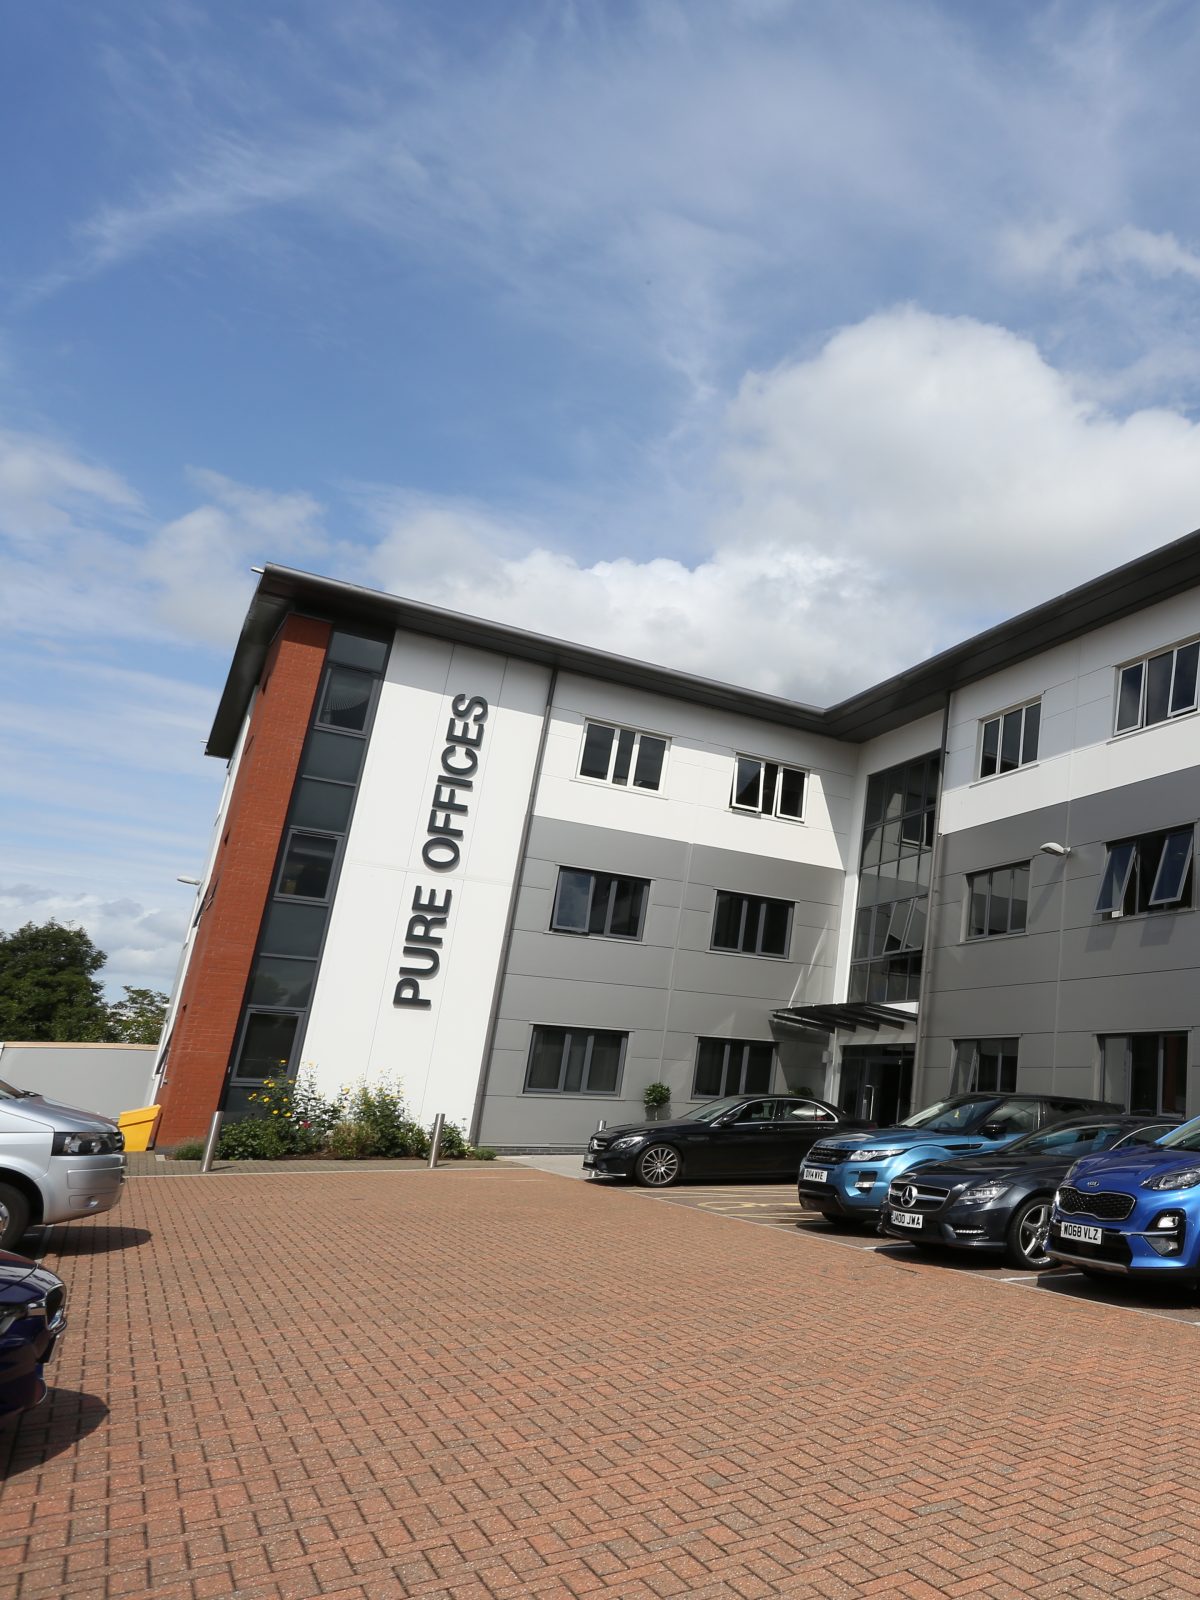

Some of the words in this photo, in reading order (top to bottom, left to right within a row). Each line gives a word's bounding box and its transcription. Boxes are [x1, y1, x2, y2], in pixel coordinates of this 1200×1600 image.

[421, 693, 489, 869] OFFICES
[392, 885, 453, 1009] PURE
[1083, 1227, 1099, 1241] VLZ
